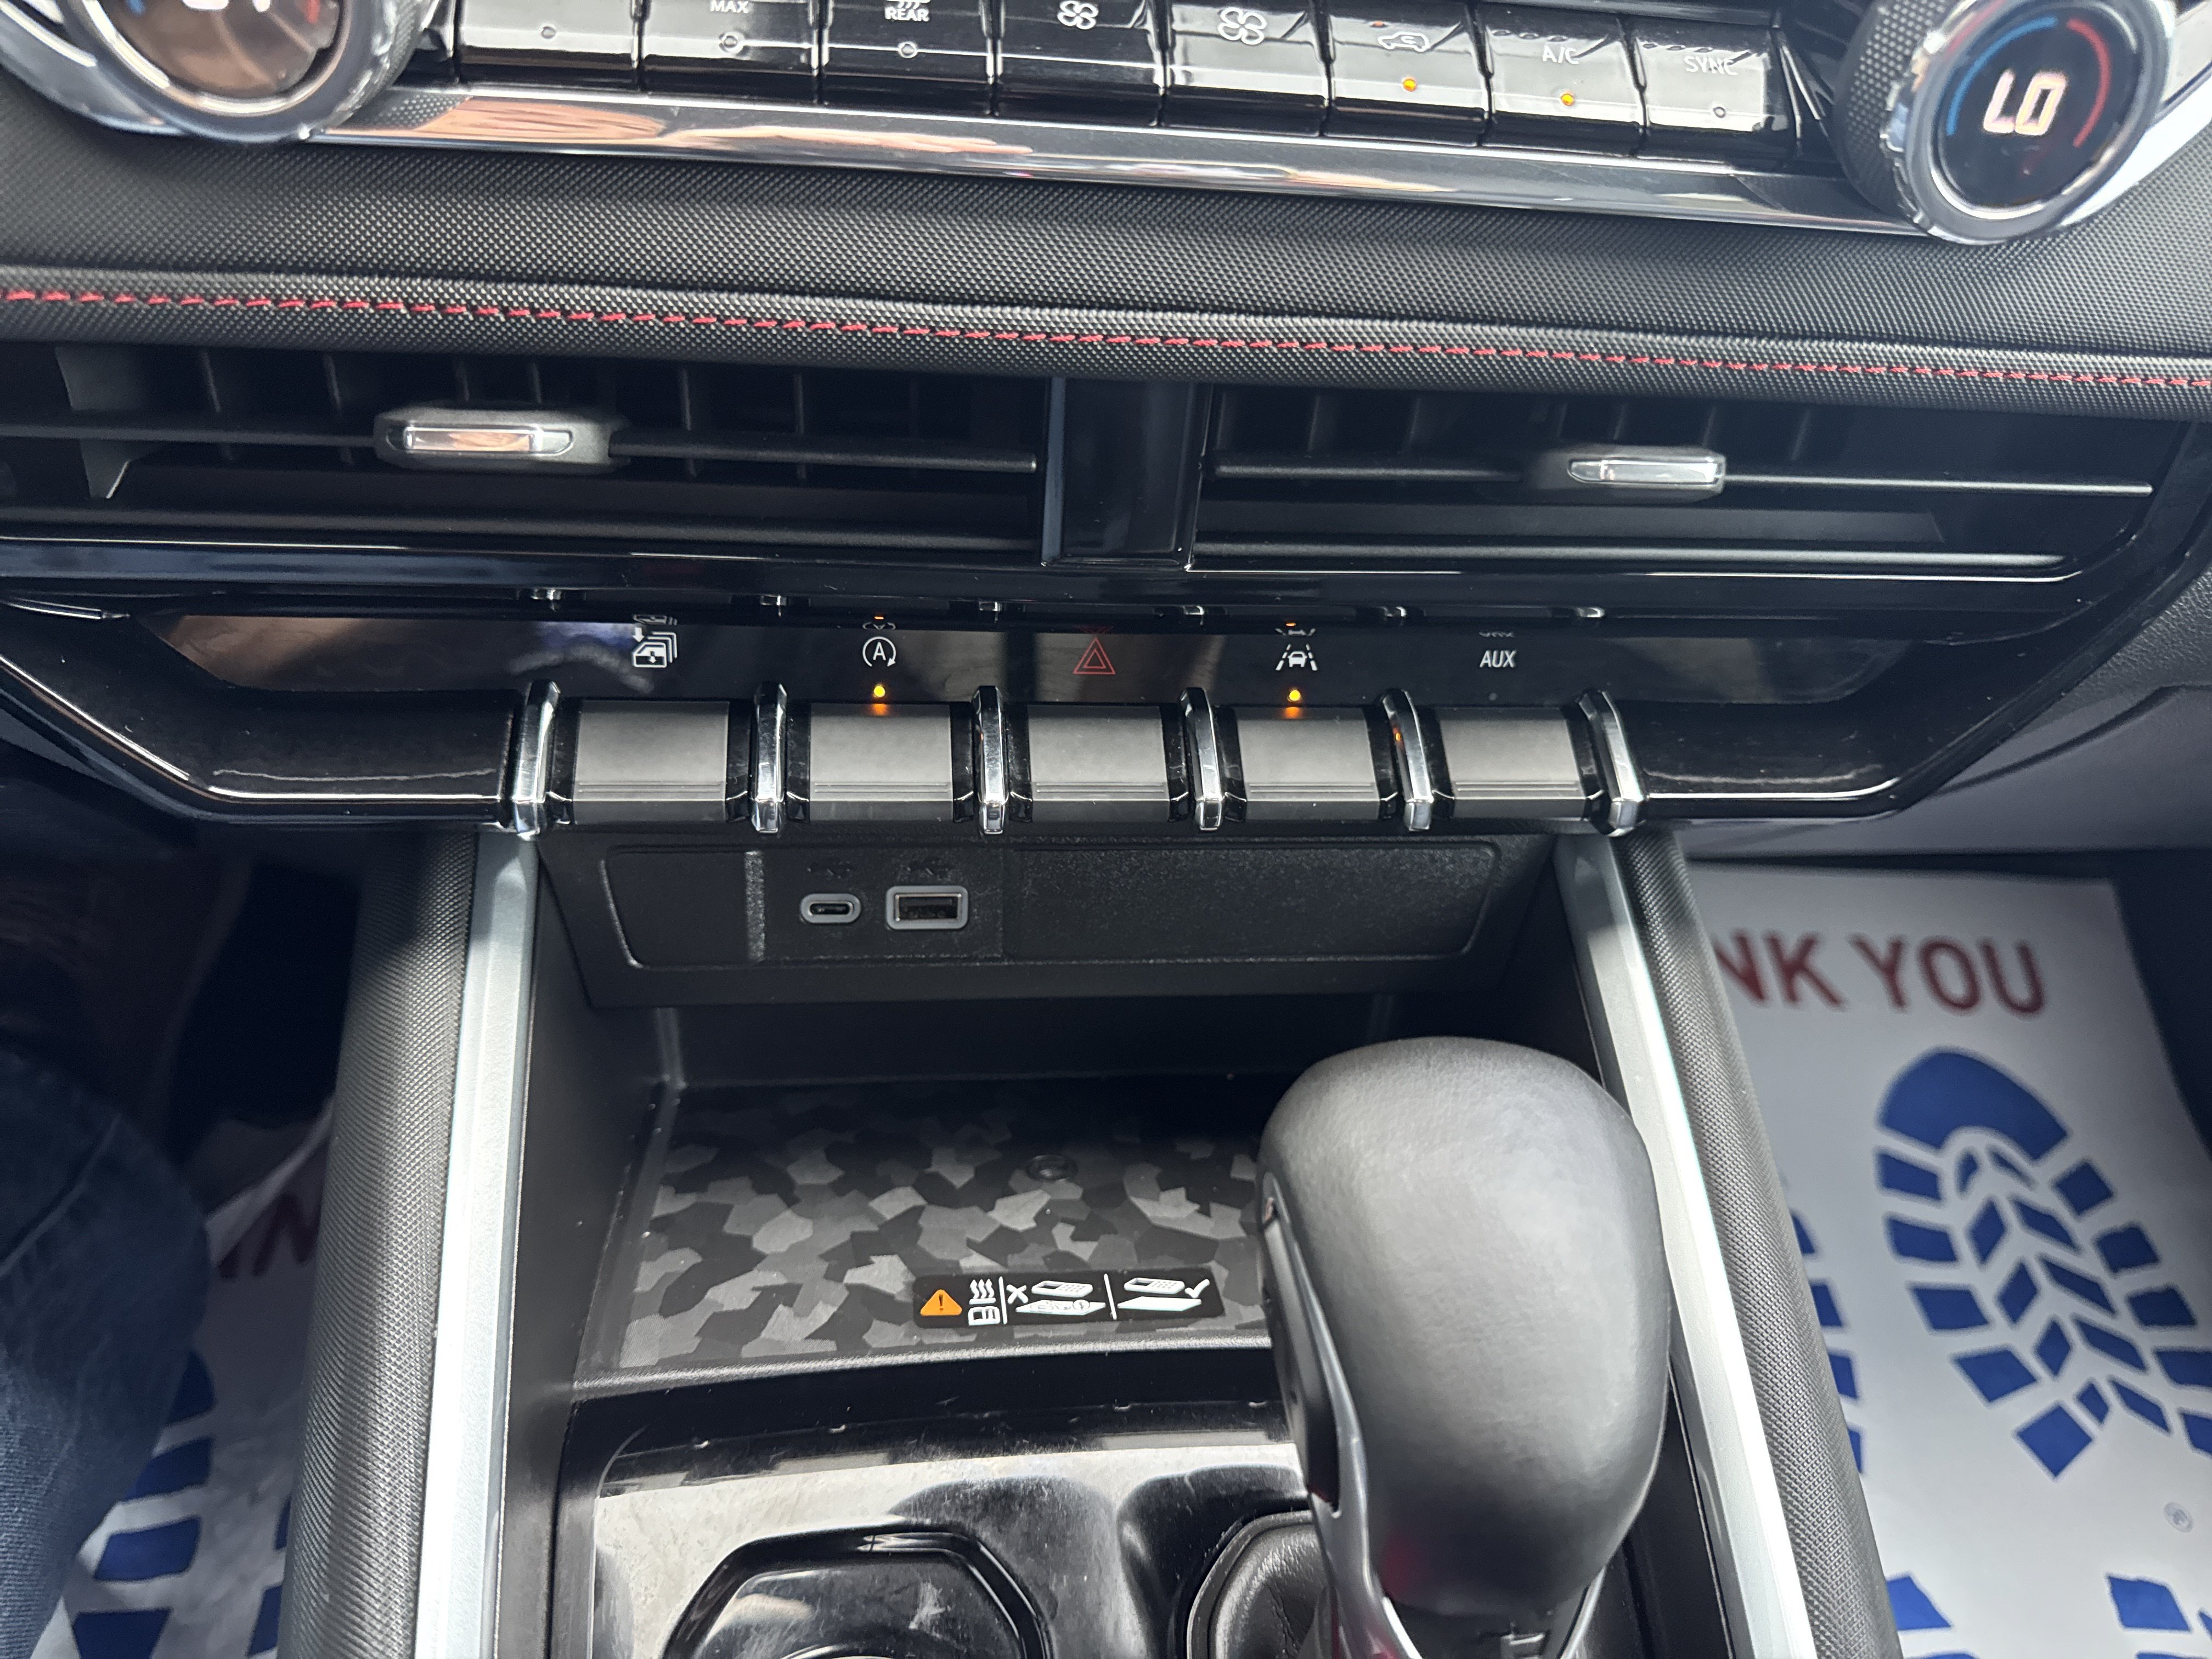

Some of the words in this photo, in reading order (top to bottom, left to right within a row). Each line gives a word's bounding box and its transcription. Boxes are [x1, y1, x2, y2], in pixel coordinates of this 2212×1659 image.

[710, 0, 748, 14] MAX
[884, 7, 930, 22] REAR
[1542, 43, 1579, 65] A/C
[1684, 55, 1738, 76] SYNC
[872, 641, 887, 661] A
[1479, 650, 1517, 668] AUX
[1849, 935, 2046, 1019] YOU
